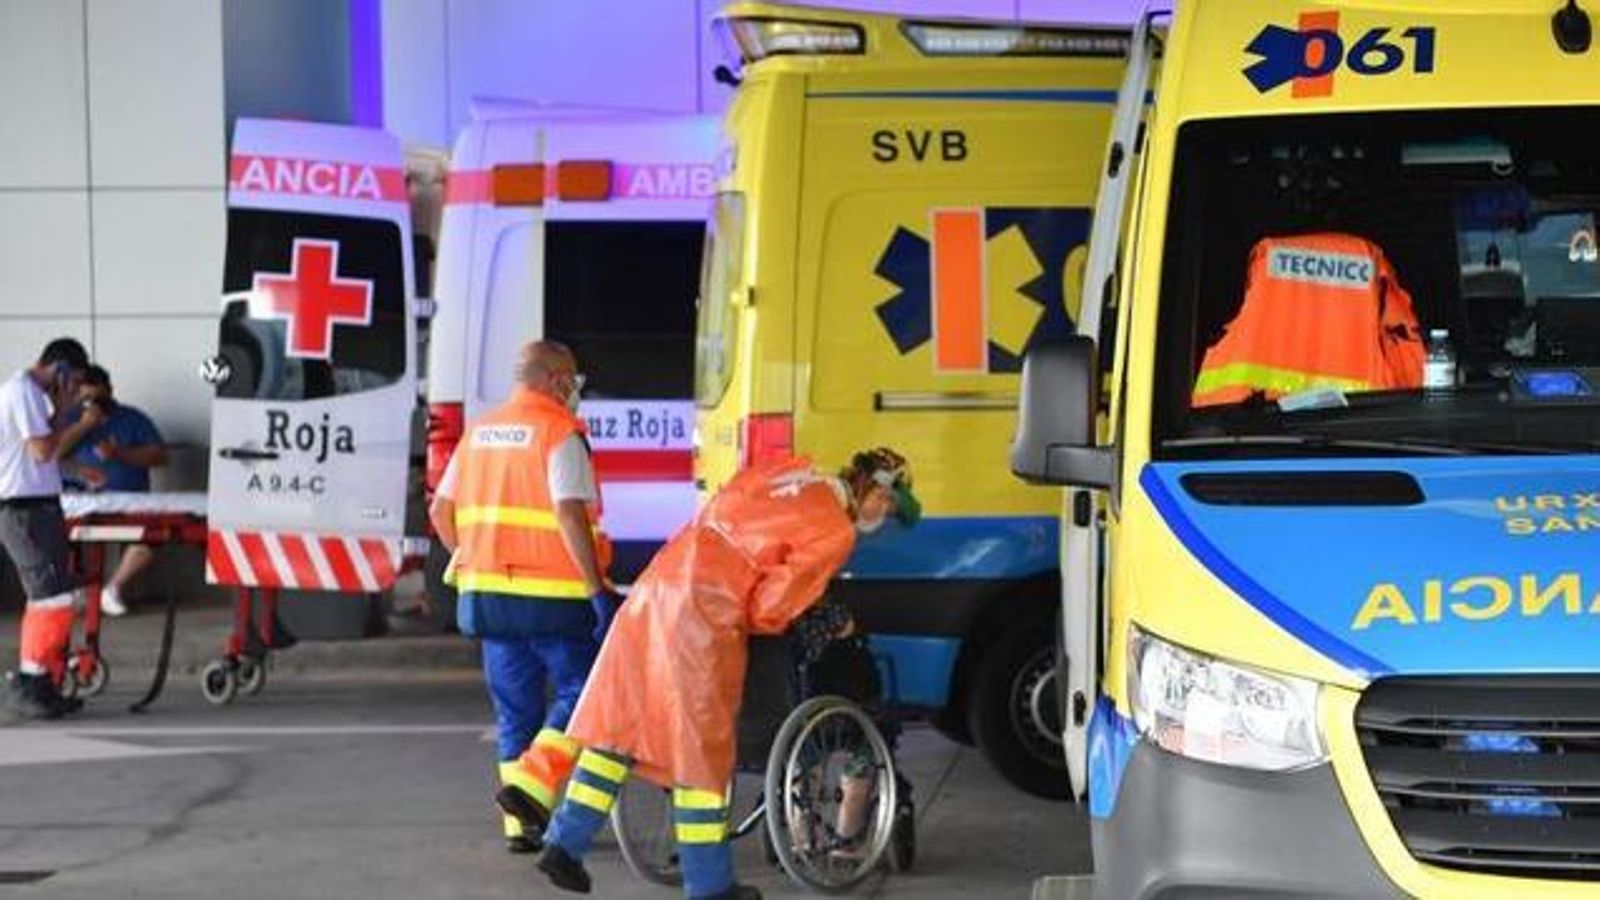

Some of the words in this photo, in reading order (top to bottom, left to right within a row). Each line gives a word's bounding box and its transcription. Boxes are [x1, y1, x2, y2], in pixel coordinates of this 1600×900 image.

[1293, 26, 1436, 76] 061
[872, 129, 968, 163] SVB
[264, 409, 356, 464] Roja
[627, 408, 685, 446] Roja
[247, 473, 263, 492] A
